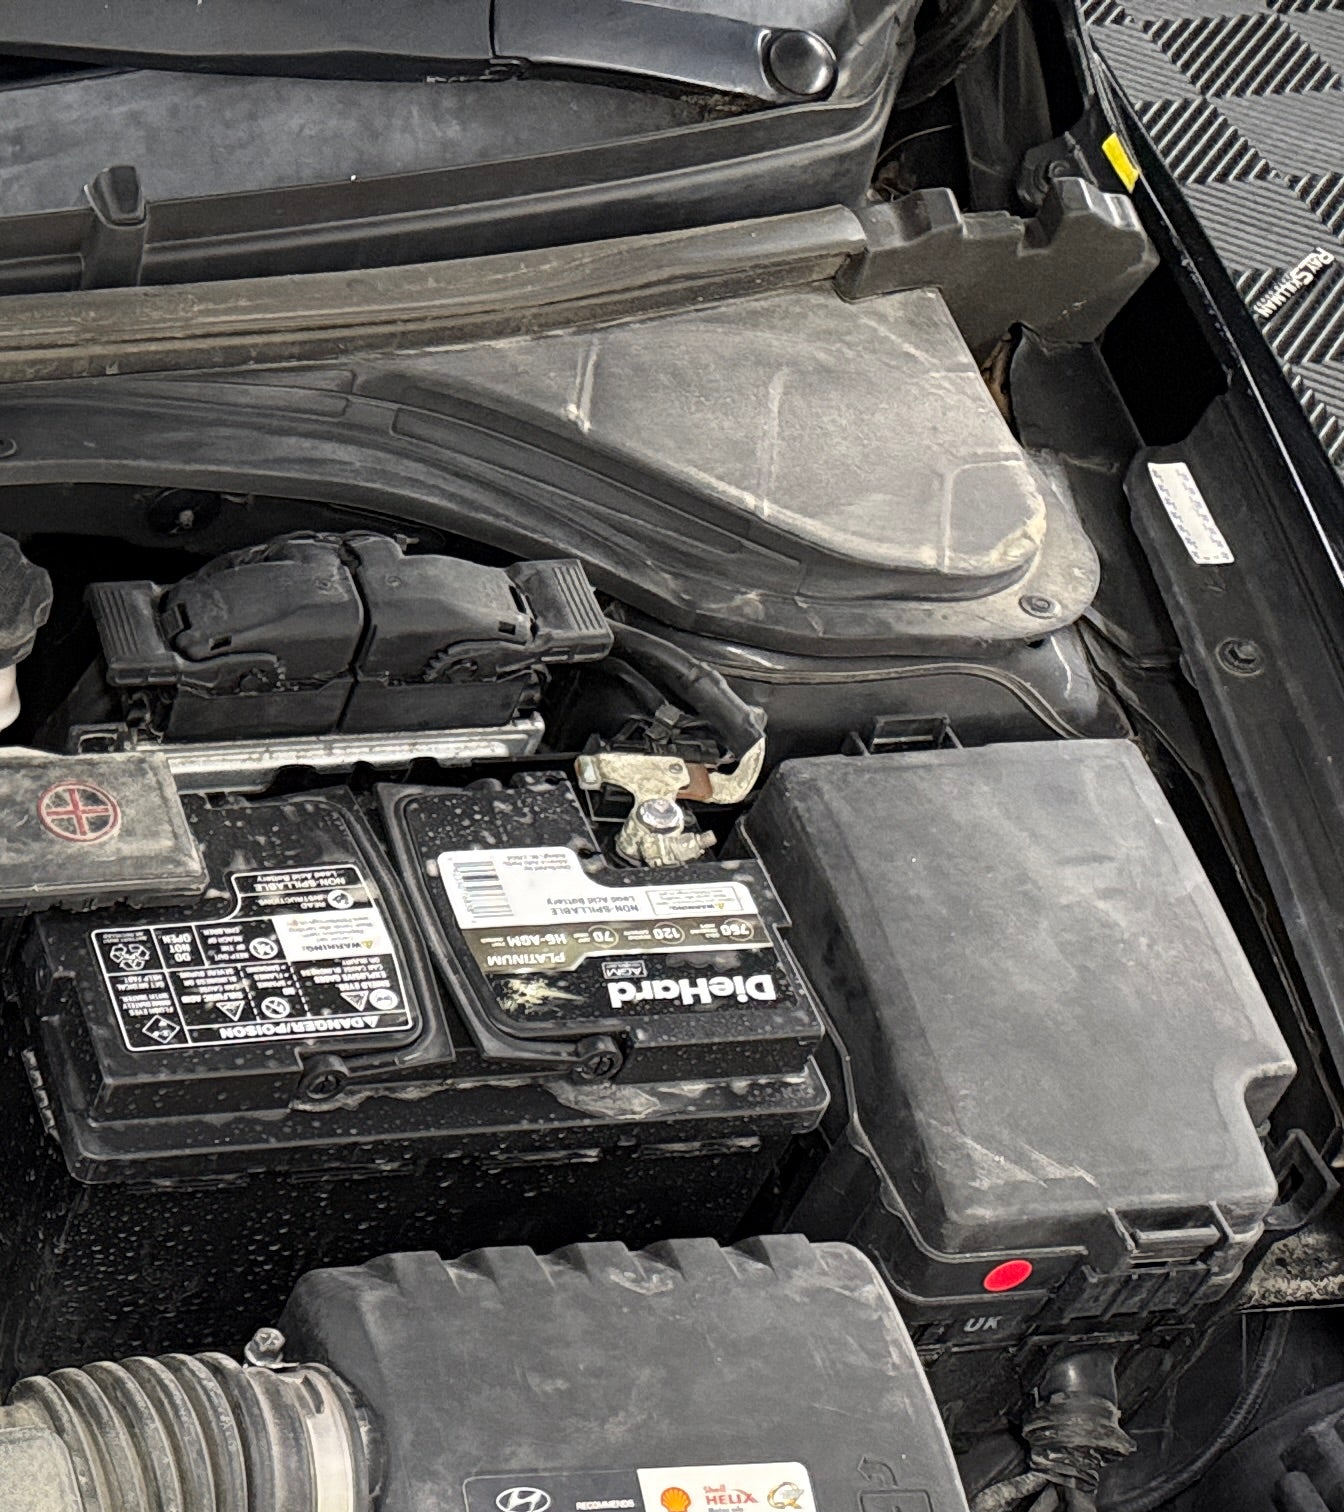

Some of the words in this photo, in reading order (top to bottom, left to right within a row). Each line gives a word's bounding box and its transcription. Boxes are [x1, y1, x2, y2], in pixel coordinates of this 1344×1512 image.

[591, 930, 614, 942] 70
[651, 926, 681, 940] 120
[167, 942, 191, 953] NOT
[173, 952, 192, 962] DO
[487, 951, 567, 967] PLATINUM
[605, 966, 644, 978] AGM
[606, 974, 779, 1009] DieHard
[219, 1018, 365, 1039] DANGER/POISON
[963, 1316, 1003, 1333] UK
[704, 1491, 757, 1507] HELIX
